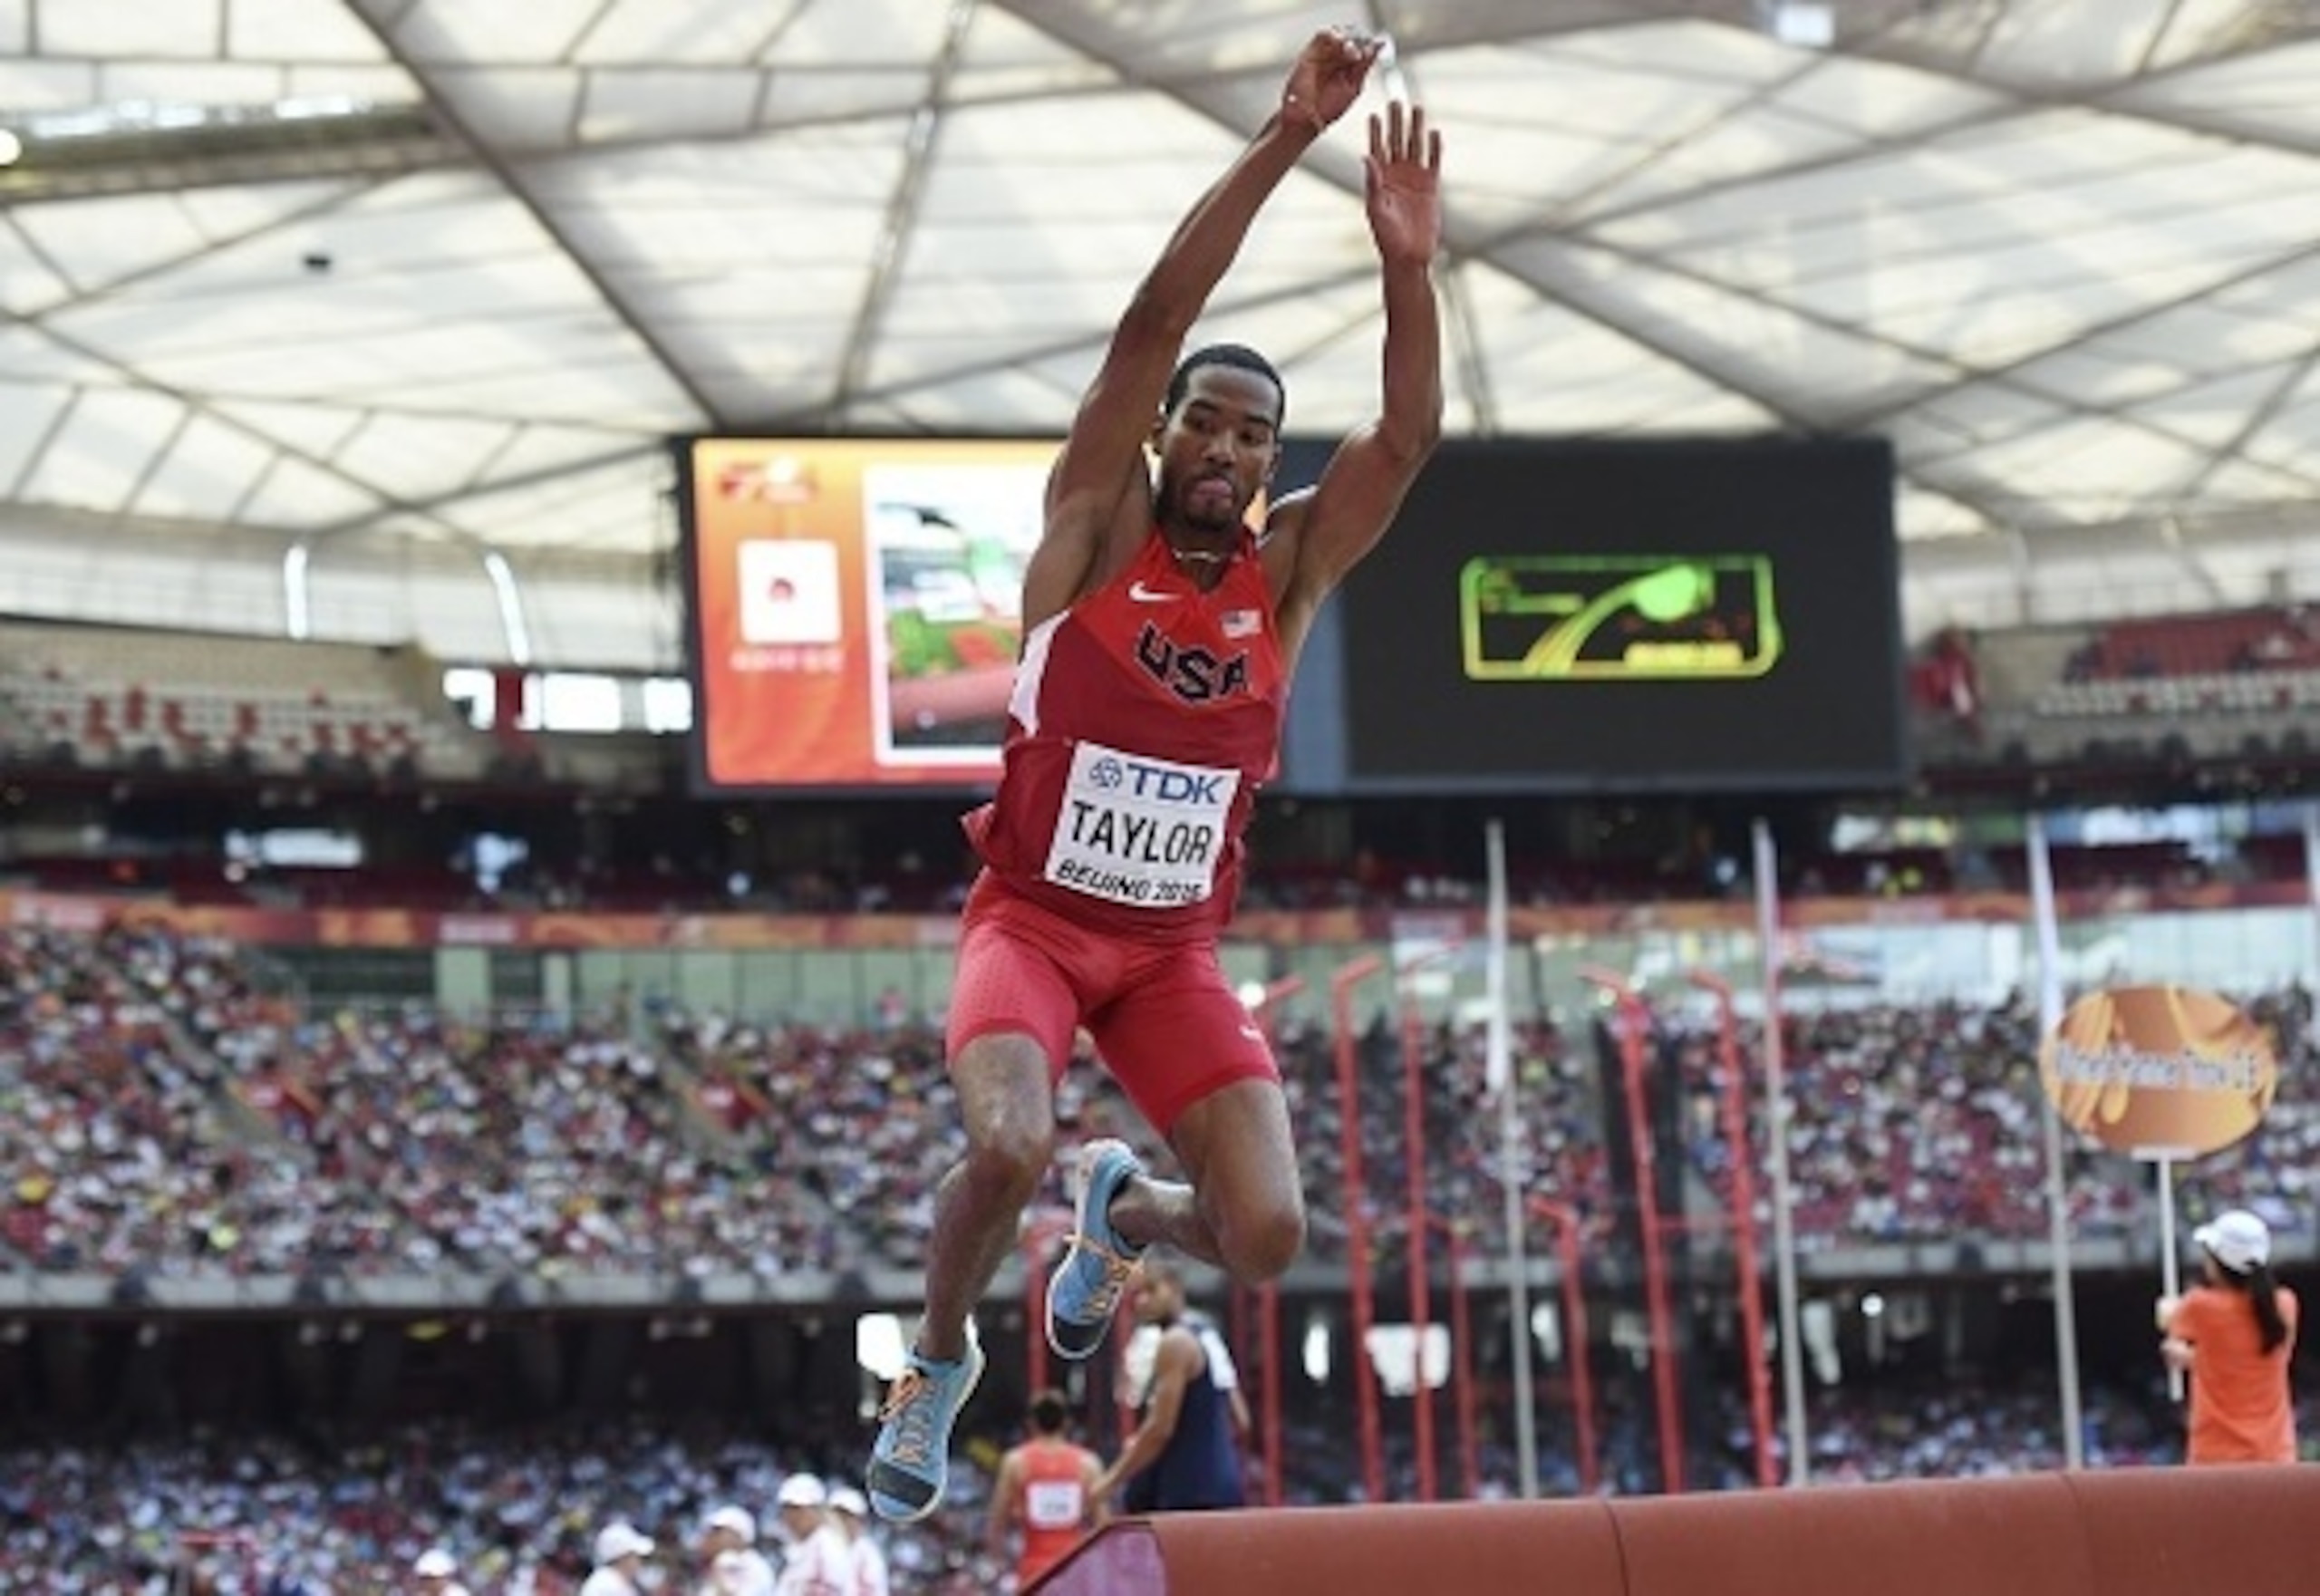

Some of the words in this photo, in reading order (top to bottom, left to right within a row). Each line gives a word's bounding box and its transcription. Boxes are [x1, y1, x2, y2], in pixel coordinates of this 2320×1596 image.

[1135, 620, 1250, 704] USA
[1126, 763, 1223, 805] TDK
[1071, 801, 1213, 866] TAYLOR
[1056, 858, 1152, 900] BEIJING
